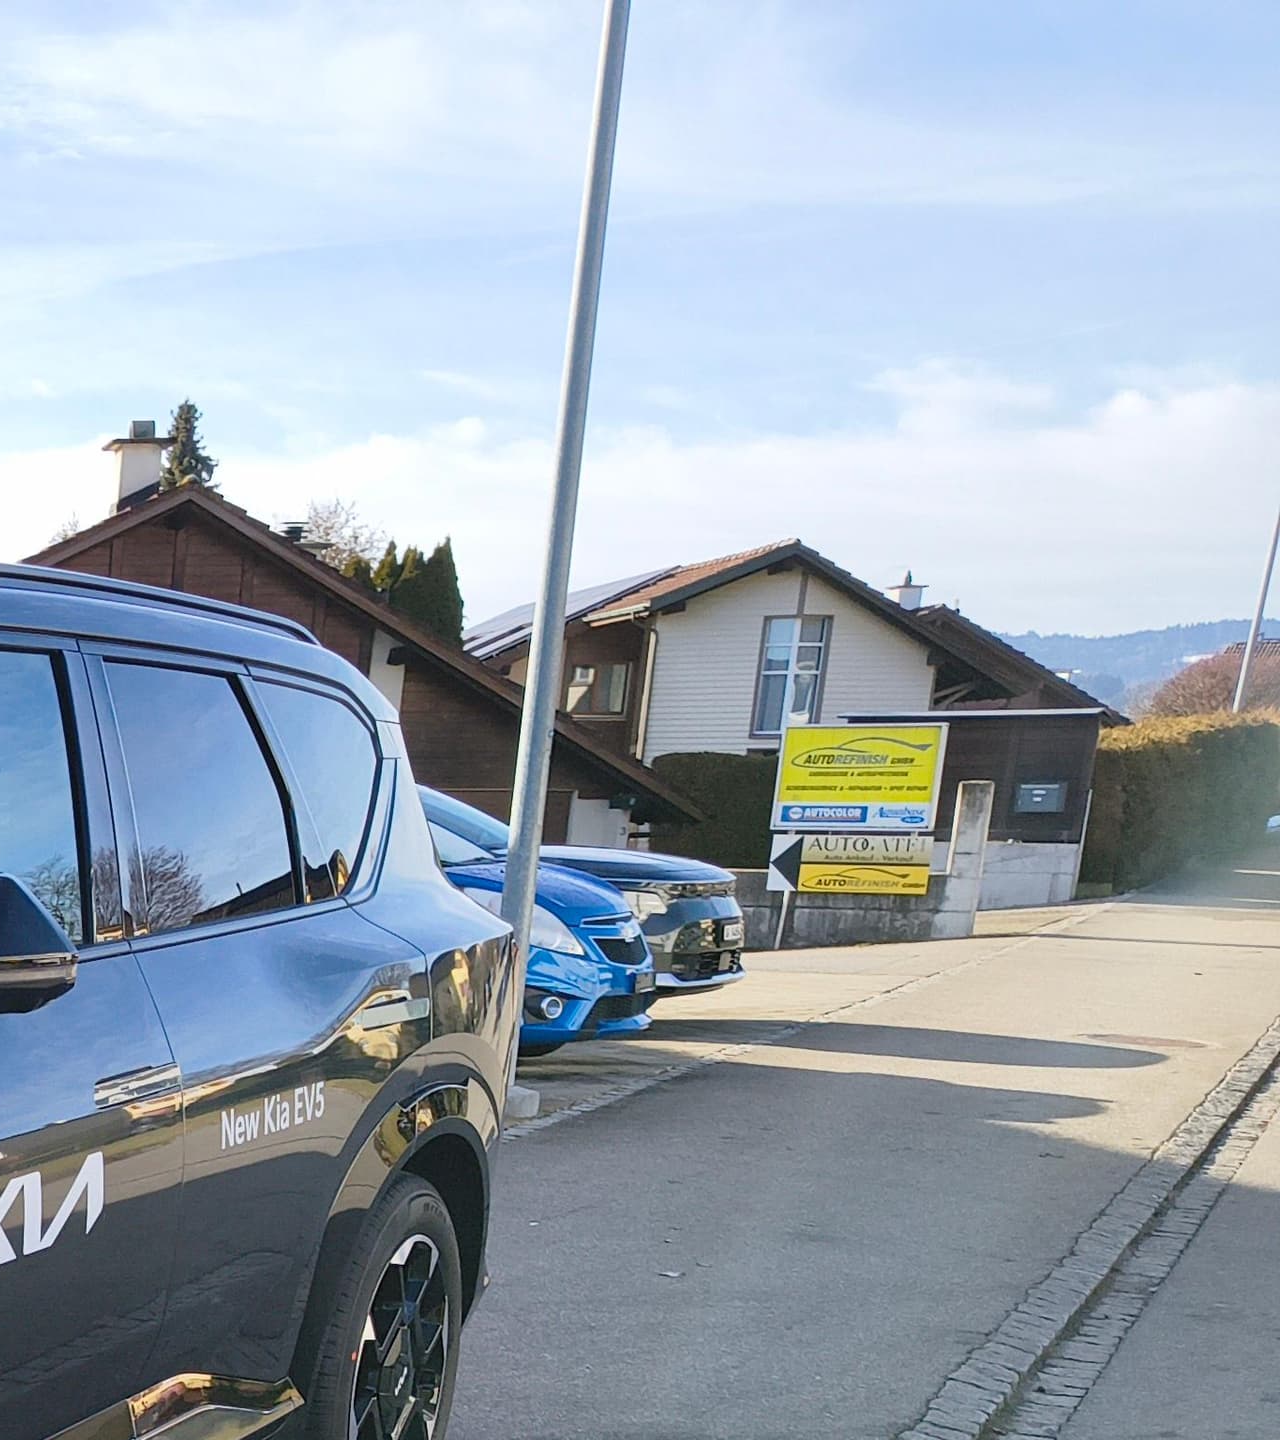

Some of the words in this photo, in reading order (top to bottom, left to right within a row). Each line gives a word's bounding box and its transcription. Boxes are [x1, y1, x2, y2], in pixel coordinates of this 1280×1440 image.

[804, 807, 862, 817] AUTOCOLOR
[221, 1107, 260, 1150] New
[263, 1093, 290, 1136] Kia
[294, 1081, 325, 1126] EV5
